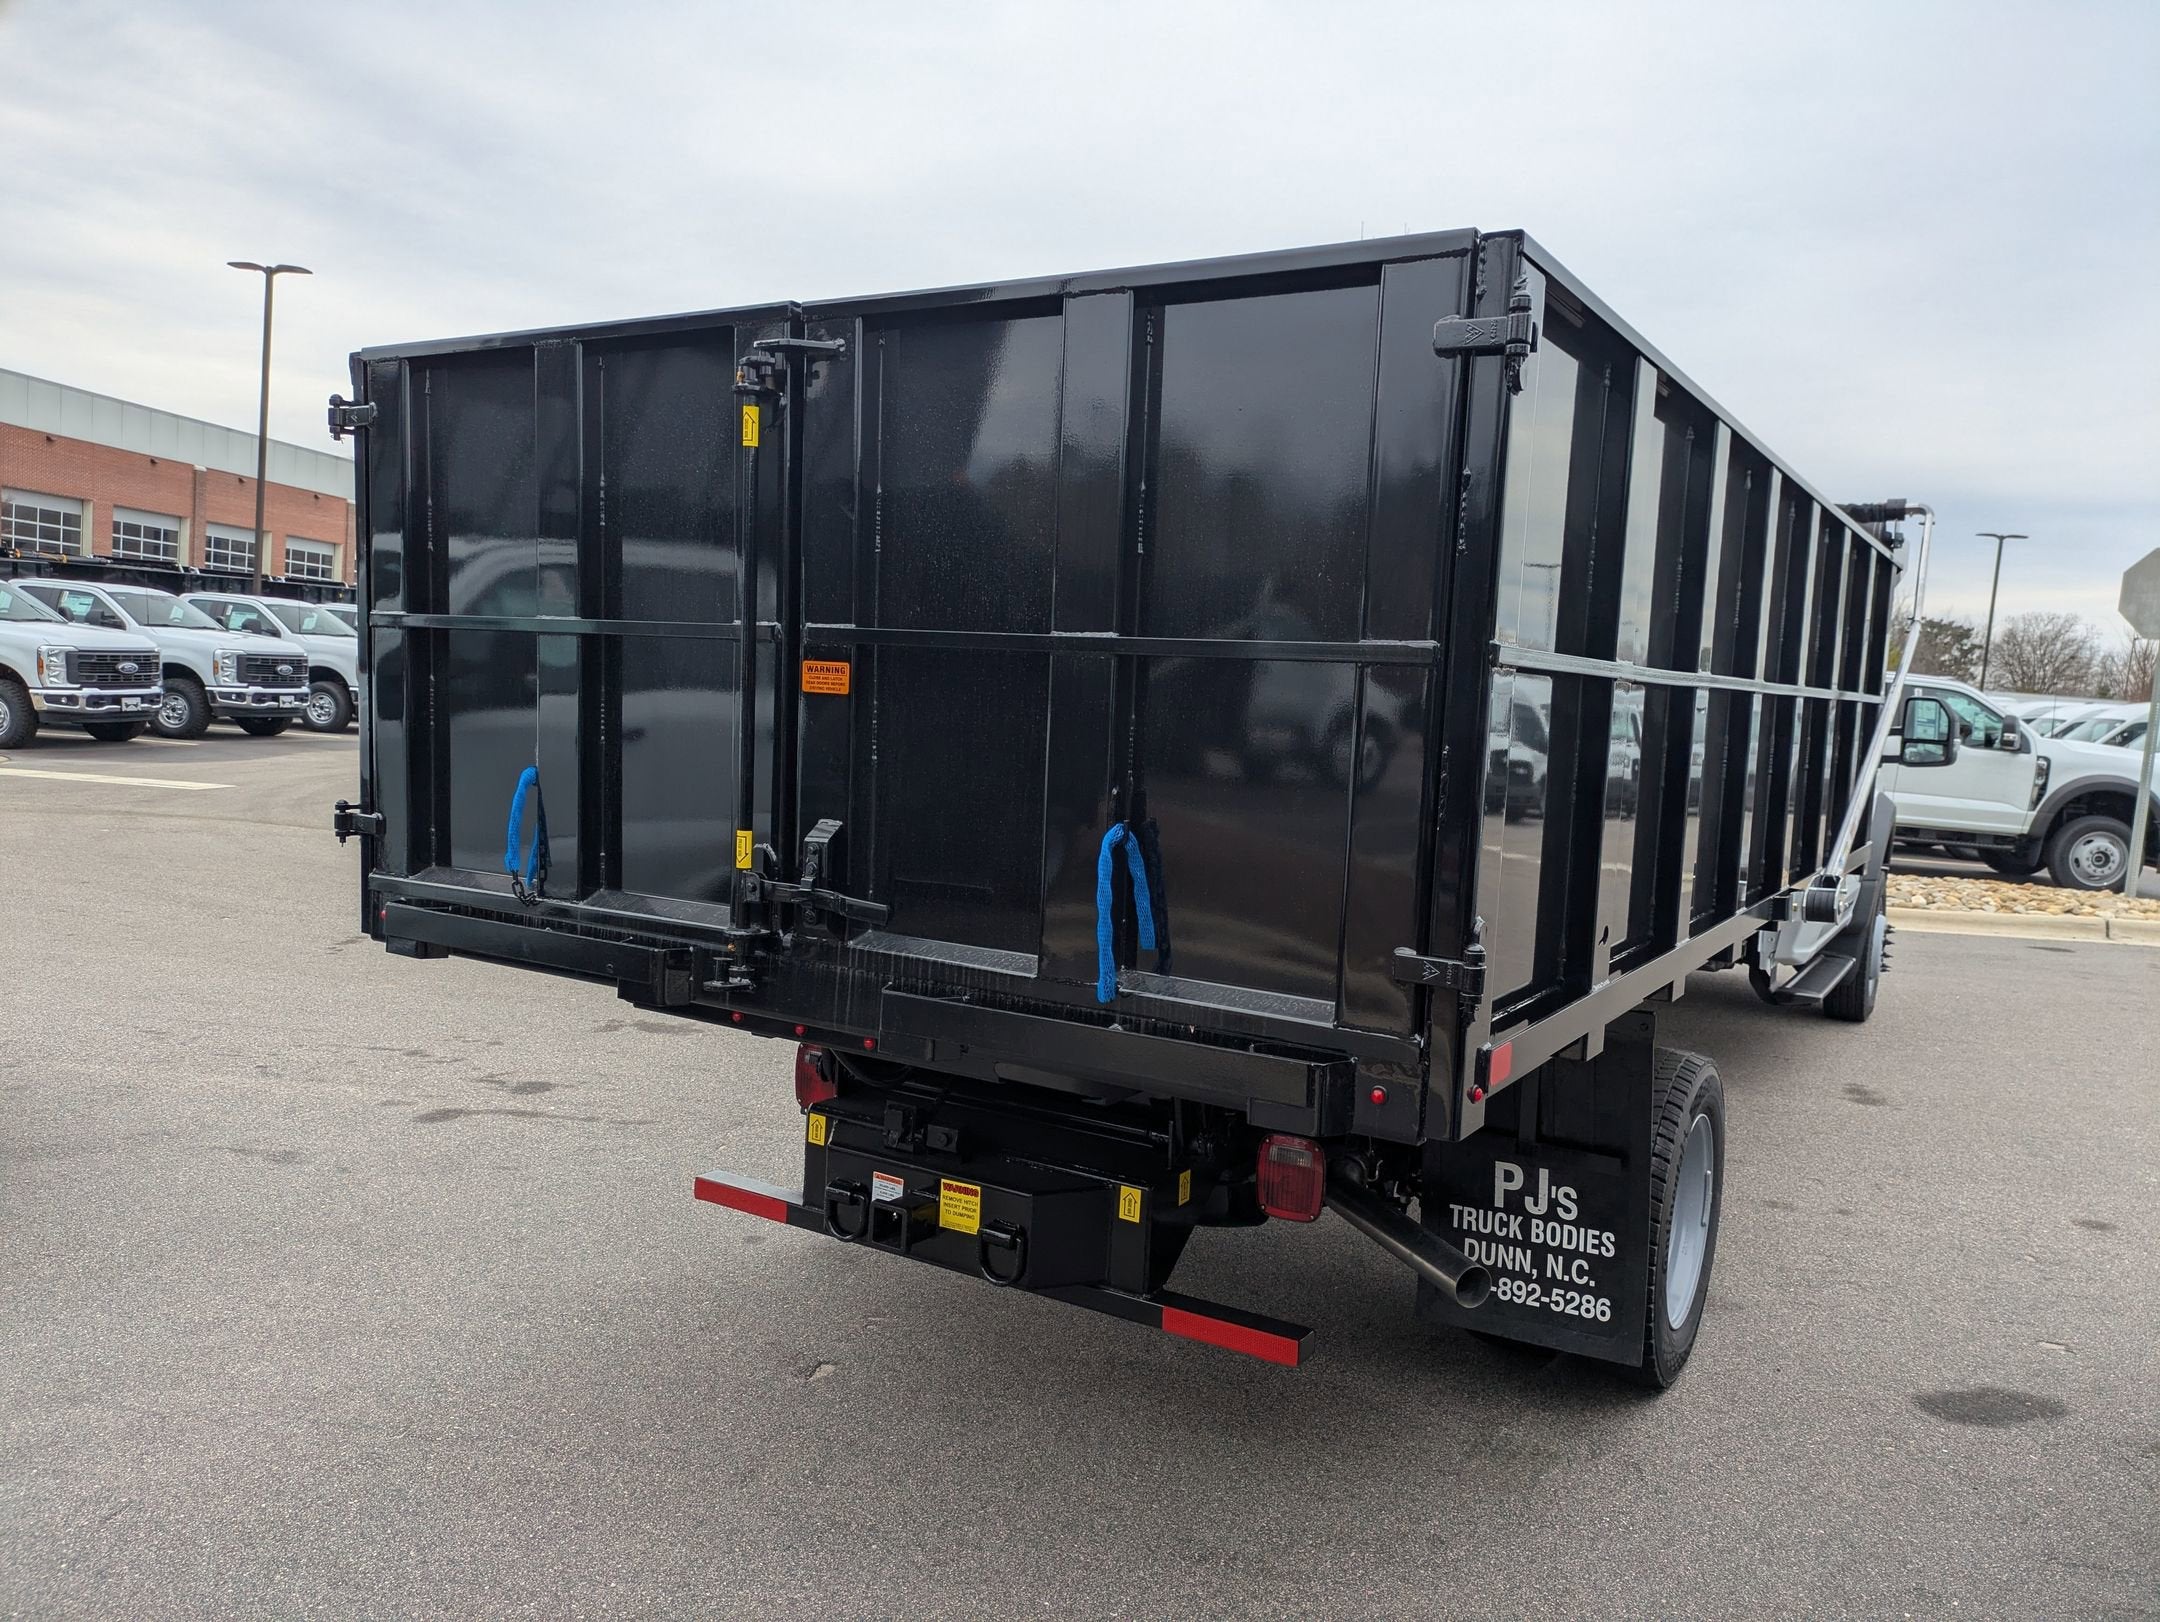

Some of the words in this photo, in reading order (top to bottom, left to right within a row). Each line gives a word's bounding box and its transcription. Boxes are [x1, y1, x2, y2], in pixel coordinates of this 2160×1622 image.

[806, 665, 845, 674] WARNING
[942, 1182, 979, 1197] WARNING
[942, 1195, 963, 1204] REMOVE
[963, 1199, 979, 1207] HITCH
[943, 1202, 961, 1211] INSERT
[961, 1205, 977, 1213] PRIOR
[952, 1210, 976, 1220] DUMPING
[1449, 1204, 1523, 1241] TRUCK
[1530, 1218, 1616, 1258] BODIES
[1463, 1238, 1538, 1280] DUNN,
[1546, 1253, 1596, 1287] N.C.
